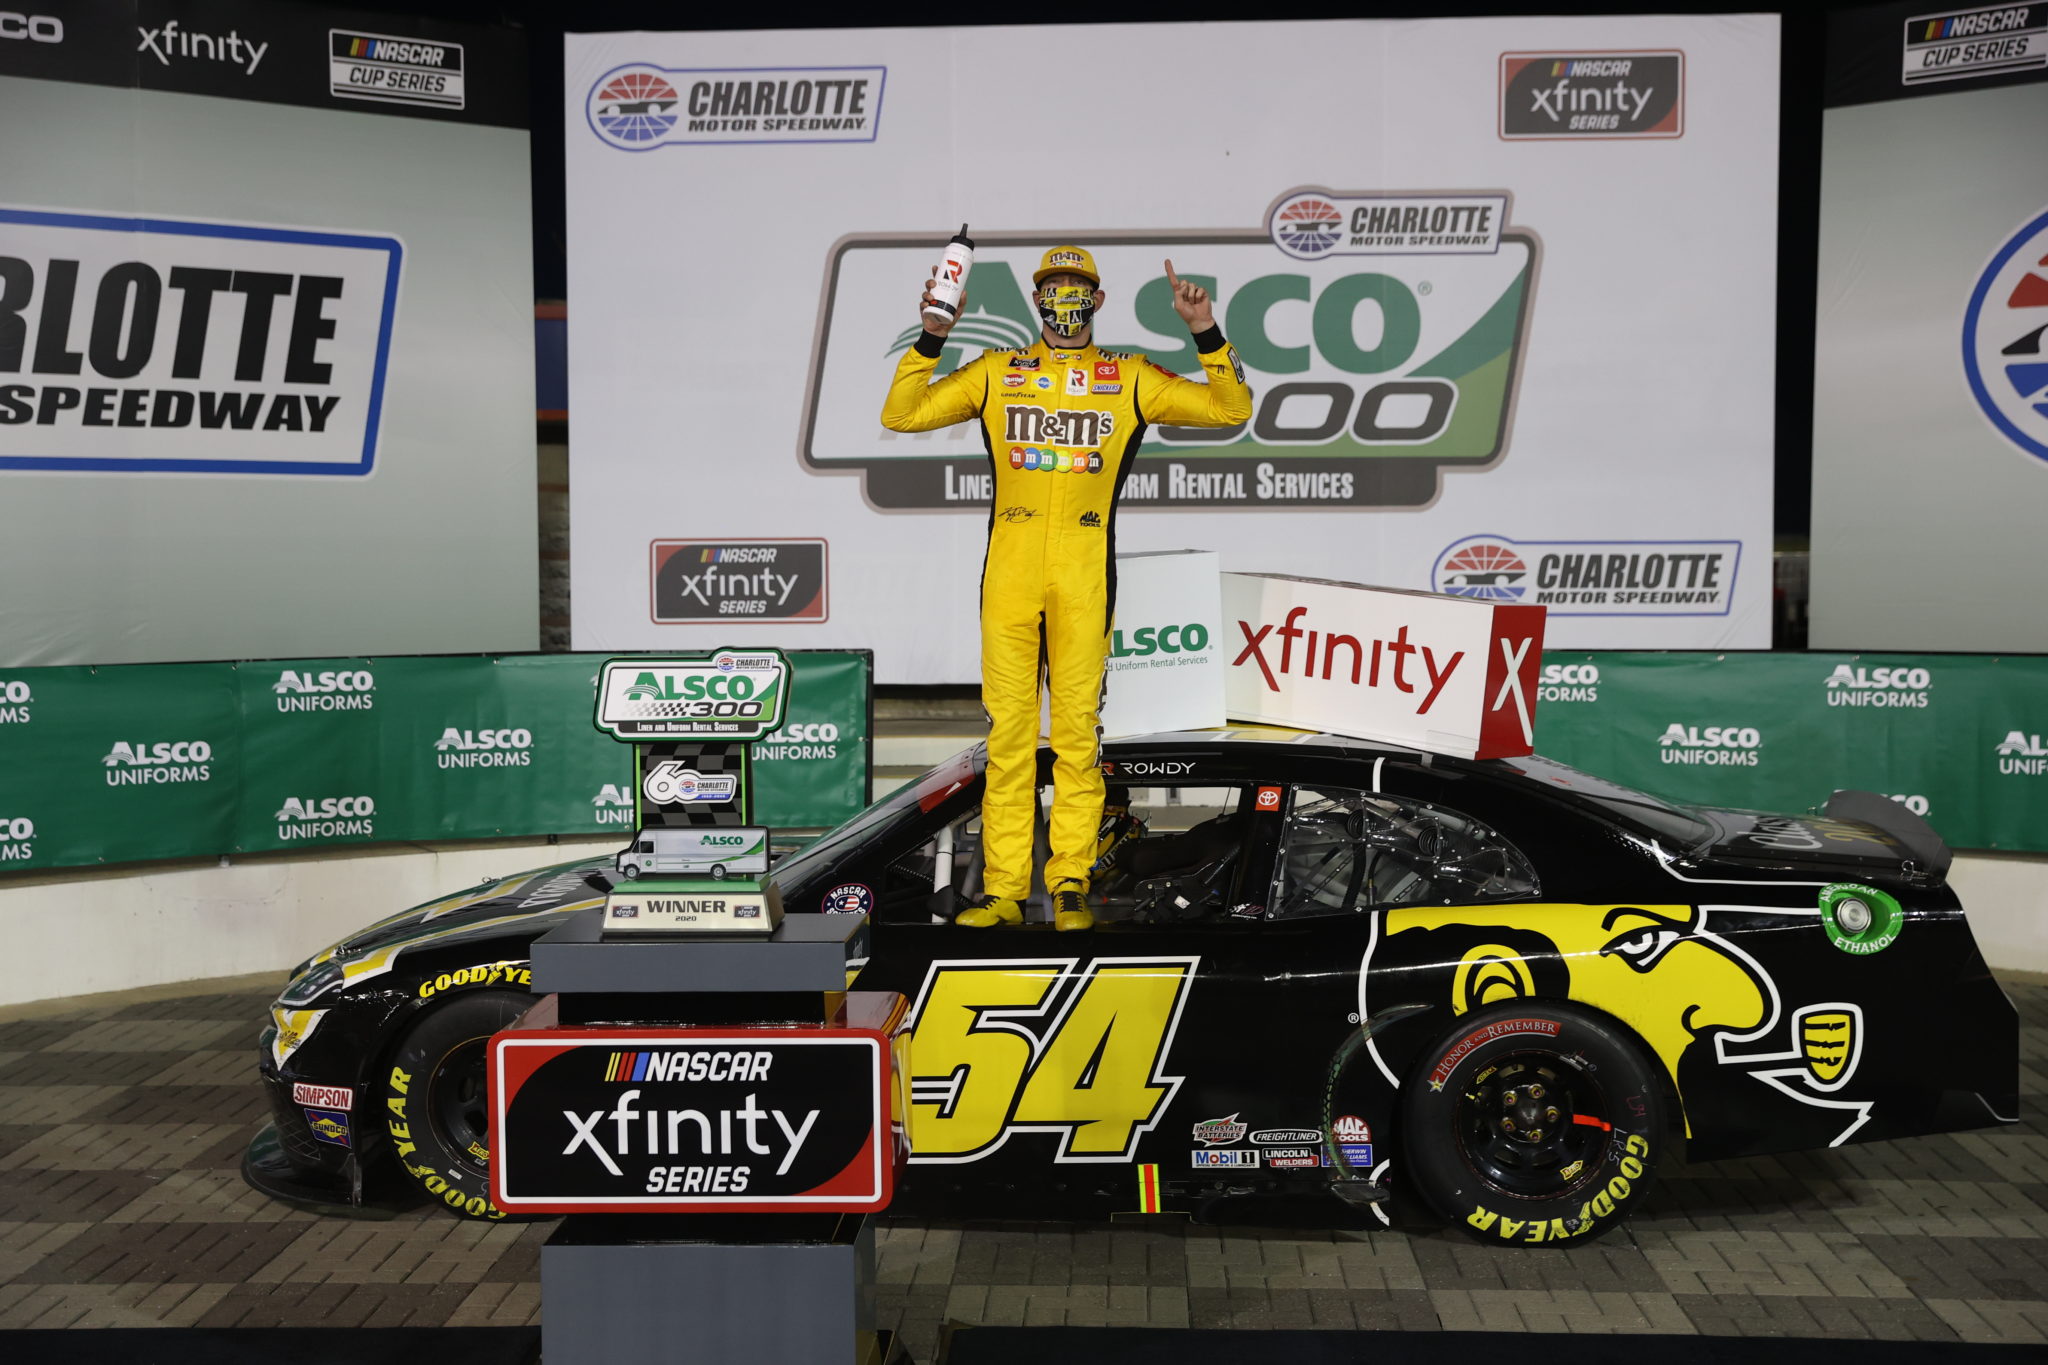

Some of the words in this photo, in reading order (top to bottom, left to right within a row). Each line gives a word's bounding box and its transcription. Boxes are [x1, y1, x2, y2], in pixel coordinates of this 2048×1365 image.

[1950, 8, 2029, 37] NASCAR
[138, 20, 268, 75] xfinity
[373, 38, 444, 67] NASCAR
[1923, 45, 1960, 67] CUP
[1962, 38, 2029, 63] SERIES
[350, 67, 384, 86] CUP
[386, 71, 446, 93] SERIES
[1571, 60, 1632, 77] NASCAR
[688, 80, 868, 117] CHARLOTTE
[1530, 79, 1653, 121] xfinity
[688, 119, 756, 132] MOTOR
[763, 117, 866, 131] SPEEDWAY
[1569, 115, 1620, 130] SERIES
[1350, 206, 1492, 234] CHARLOTTE
[1350, 236, 1403, 246] MOTOR
[1409, 235, 1489, 246] SPEEDWAY
[884, 262, 1421, 375] ASCO
[0, 385, 341, 432] SPEEDWAY
[1157, 382, 1455, 441] 00
[719, 549, 777, 563] NASCAR
[1537, 554, 1722, 589] CHARLOTTE
[681, 565, 799, 606] xfinity
[719, 600, 767, 614] SERIES
[1537, 592, 1606, 604] MOTOR
[1614, 591, 1719, 604] SPEEDWAY
[1107, 623, 1208, 658] LSCO
[1116, 660, 1148, 672] Uniform
[1151, 657, 1175, 668] Rental
[1178, 655, 1208, 666] Services
[1232, 606, 1465, 715] xfinity
[272, 670, 374, 694] ALSCO
[623, 672, 755, 701] ALSCO
[1824, 664, 1931, 690] ALSCO
[277, 694, 373, 713] UNIFORMS
[690, 702, 763, 717] 300
[1827, 690, 1929, 708] UNIFORMS
[434, 727, 532, 750] ALSCO
[1658, 723, 1760, 749] ALSCO
[1995, 731, 2048, 756] AL
[102, 740, 211, 767] ALSCO
[438, 750, 531, 769] UNIFORMS
[752, 745, 837, 760] UNIFORMS
[1661, 748, 1759, 766] UNIFORMS
[106, 765, 210, 786] UNIFORMS
[1121, 762, 1196, 775] ROWDY
[2000, 758, 2048, 775] UNIF
[274, 796, 375, 821] ALSCO
[278, 819, 373, 841] UNIFORMS
[700, 835, 743, 845] ALSCO
[830, 886, 867, 900] NASCAR
[647, 900, 726, 913] WINNER
[1834, 933, 1896, 953] ETHANOL
[645, 1051, 773, 1081] NASCAR
[910, 957, 1201, 1164] 54
[1437, 1039, 1474, 1076] HONOR
[295, 1085, 350, 1107] SIMPSON
[313, 1122, 346, 1135] SUNOCO
[562, 1089, 821, 1176] xfinity
[1197, 1131, 1242, 1139] BATTERIES
[1256, 1132, 1317, 1142] FREIGHTLINER
[1195, 1151, 1237, 1164] Mobil
[1265, 1150, 1308, 1158] LINCOLN
[646, 1165, 751, 1192] SERIES
[1467, 1134, 1649, 1242] GOODYEAR
